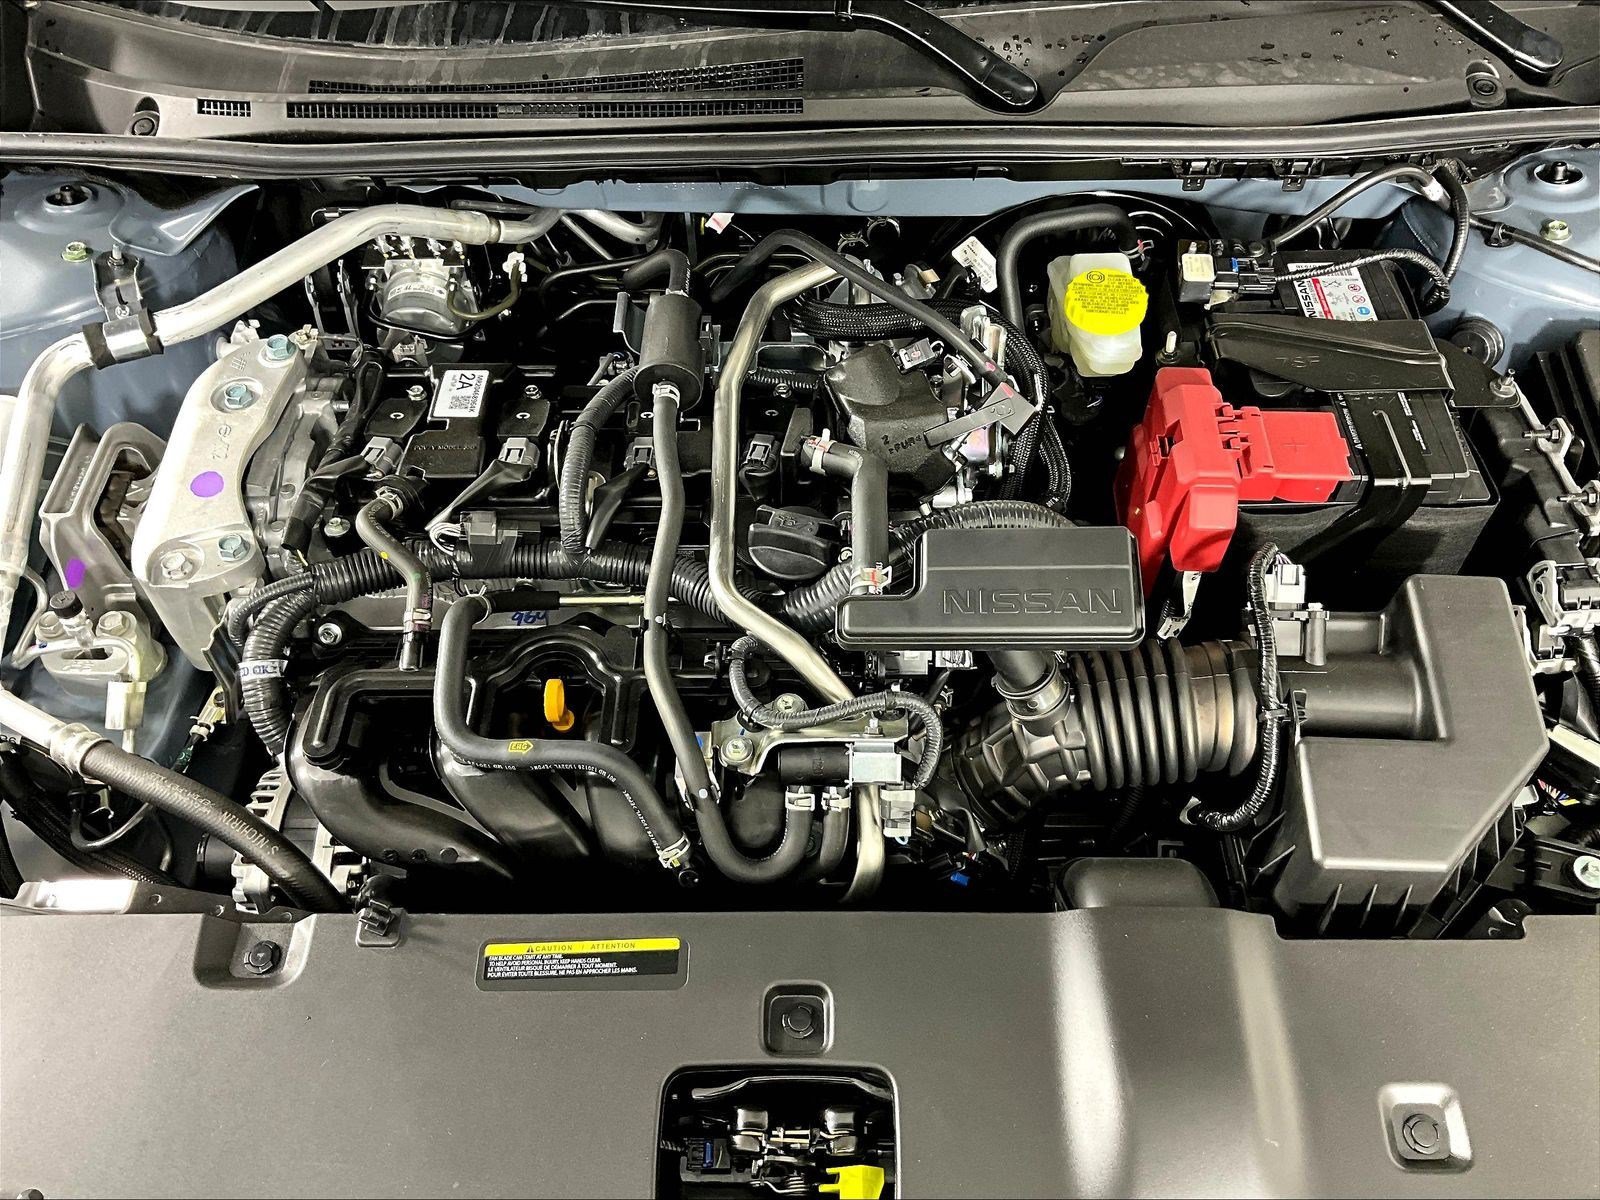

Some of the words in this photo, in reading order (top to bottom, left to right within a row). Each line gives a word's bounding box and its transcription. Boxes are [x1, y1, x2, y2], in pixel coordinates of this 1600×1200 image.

[1297, 279, 1317, 318] NISSAN
[456, 373, 476, 390] 2A
[943, 588, 1122, 614] NISSAN
[535, 944, 573, 952] CAUTION
[590, 942, 636, 950] ATTENTION
